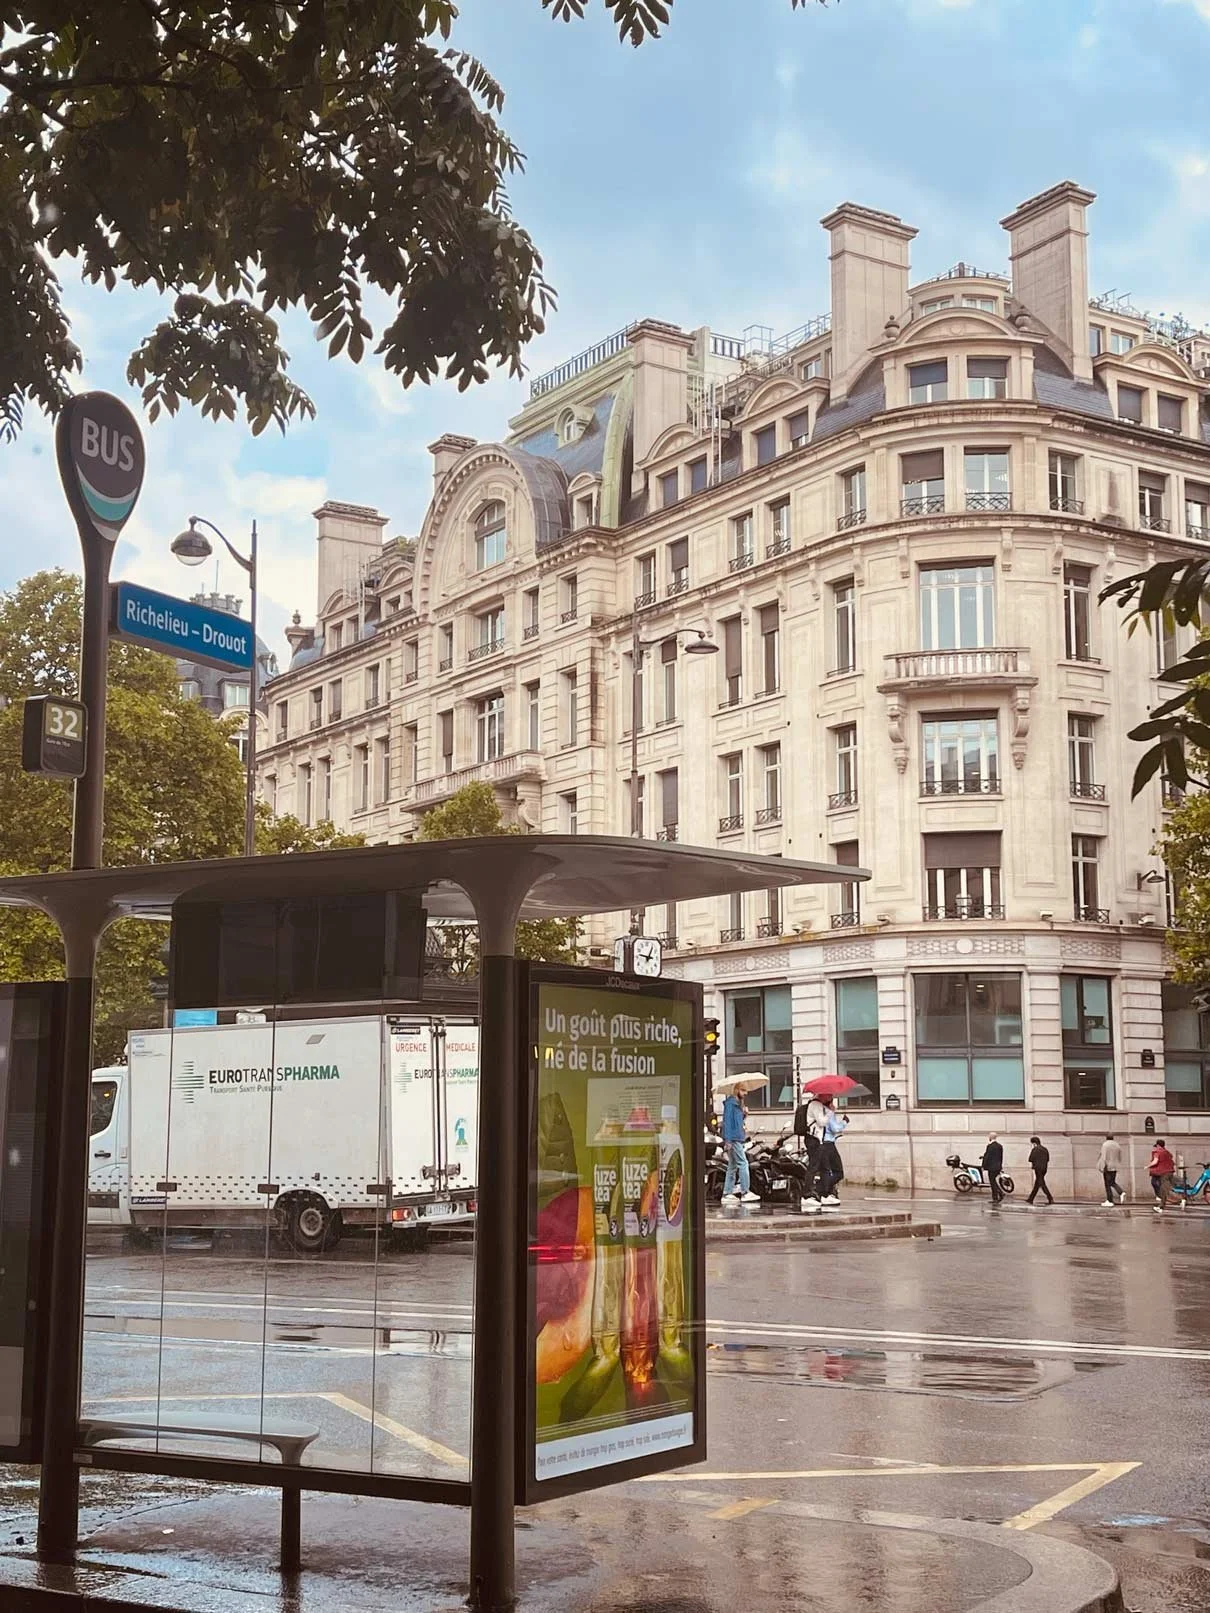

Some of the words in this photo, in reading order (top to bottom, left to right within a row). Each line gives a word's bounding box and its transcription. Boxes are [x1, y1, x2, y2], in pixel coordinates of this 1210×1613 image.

[82, 417, 134, 472] BUS
[126, 599, 189, 637] Richelieu
[202, 623, 247, 655] Drouot
[49, 706, 78, 738] 32
[545, 1007, 566, 1033] Un
[570, 1008, 606, 1041] goût
[610, 1014, 642, 1044] plus
[644, 1015, 682, 1048] riche,
[395, 1043, 428, 1052] URGENCE
[544, 1041, 564, 1069] né
[569, 1045, 588, 1070] de
[592, 1046, 606, 1072] la
[611, 1047, 656, 1074] fusion
[209, 1065, 340, 1083] EUROTRANSPHARMA
[594, 1164, 617, 1185] fuze
[622, 1156, 648, 1181] fuze
[594, 1184, 610, 1202] tea
[623, 1180, 641, 1199] tea
